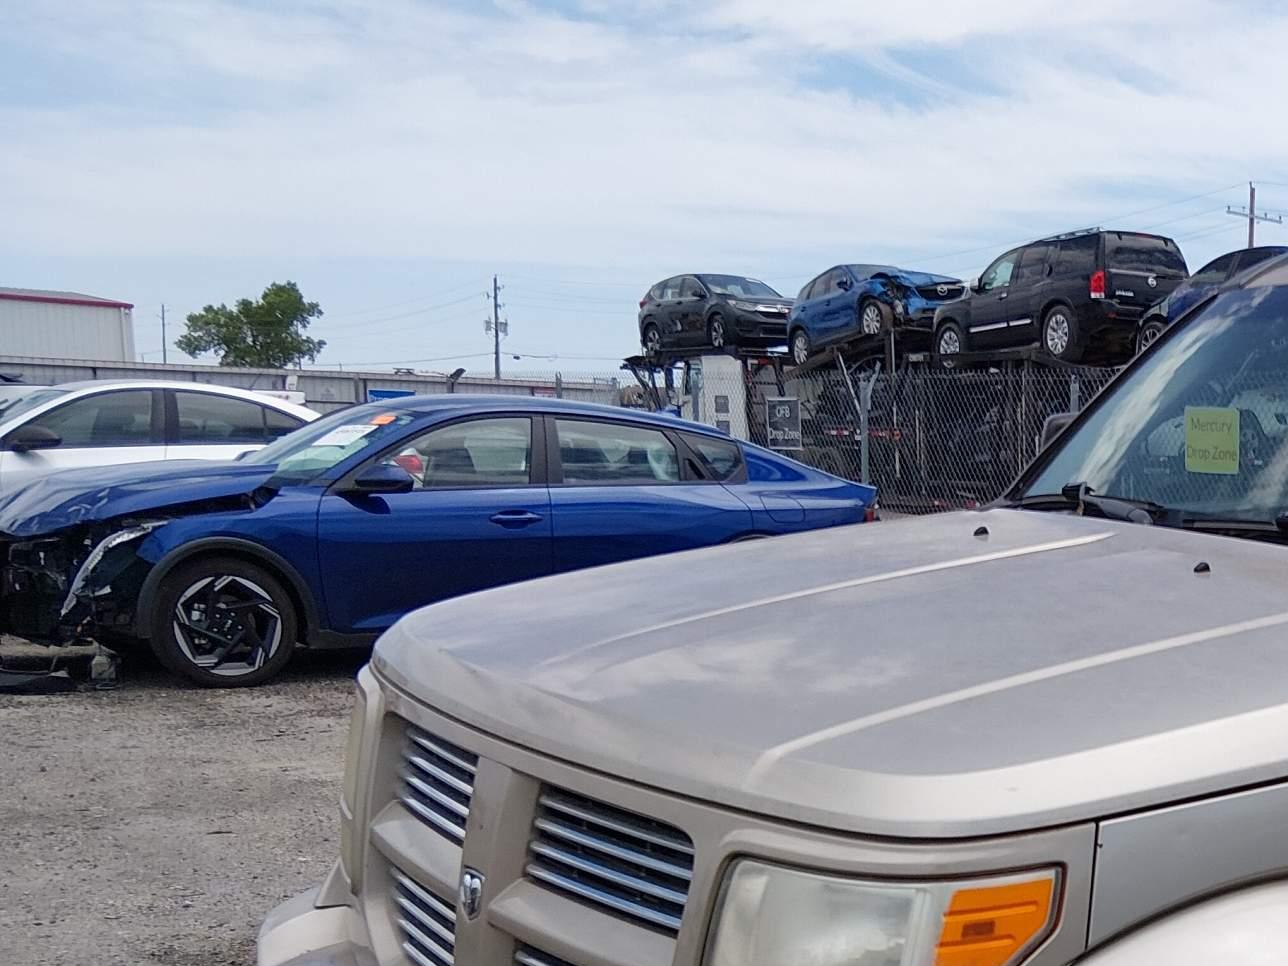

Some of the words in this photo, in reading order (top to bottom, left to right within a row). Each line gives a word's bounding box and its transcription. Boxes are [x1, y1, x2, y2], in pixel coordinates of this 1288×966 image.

[769, 427, 783, 442] Drop
[784, 427, 801, 440] Zone
[1190, 417, 1232, 435] Mercury
[1187, 445, 1210, 462] Drop
[1211, 445, 1237, 462] Zone
